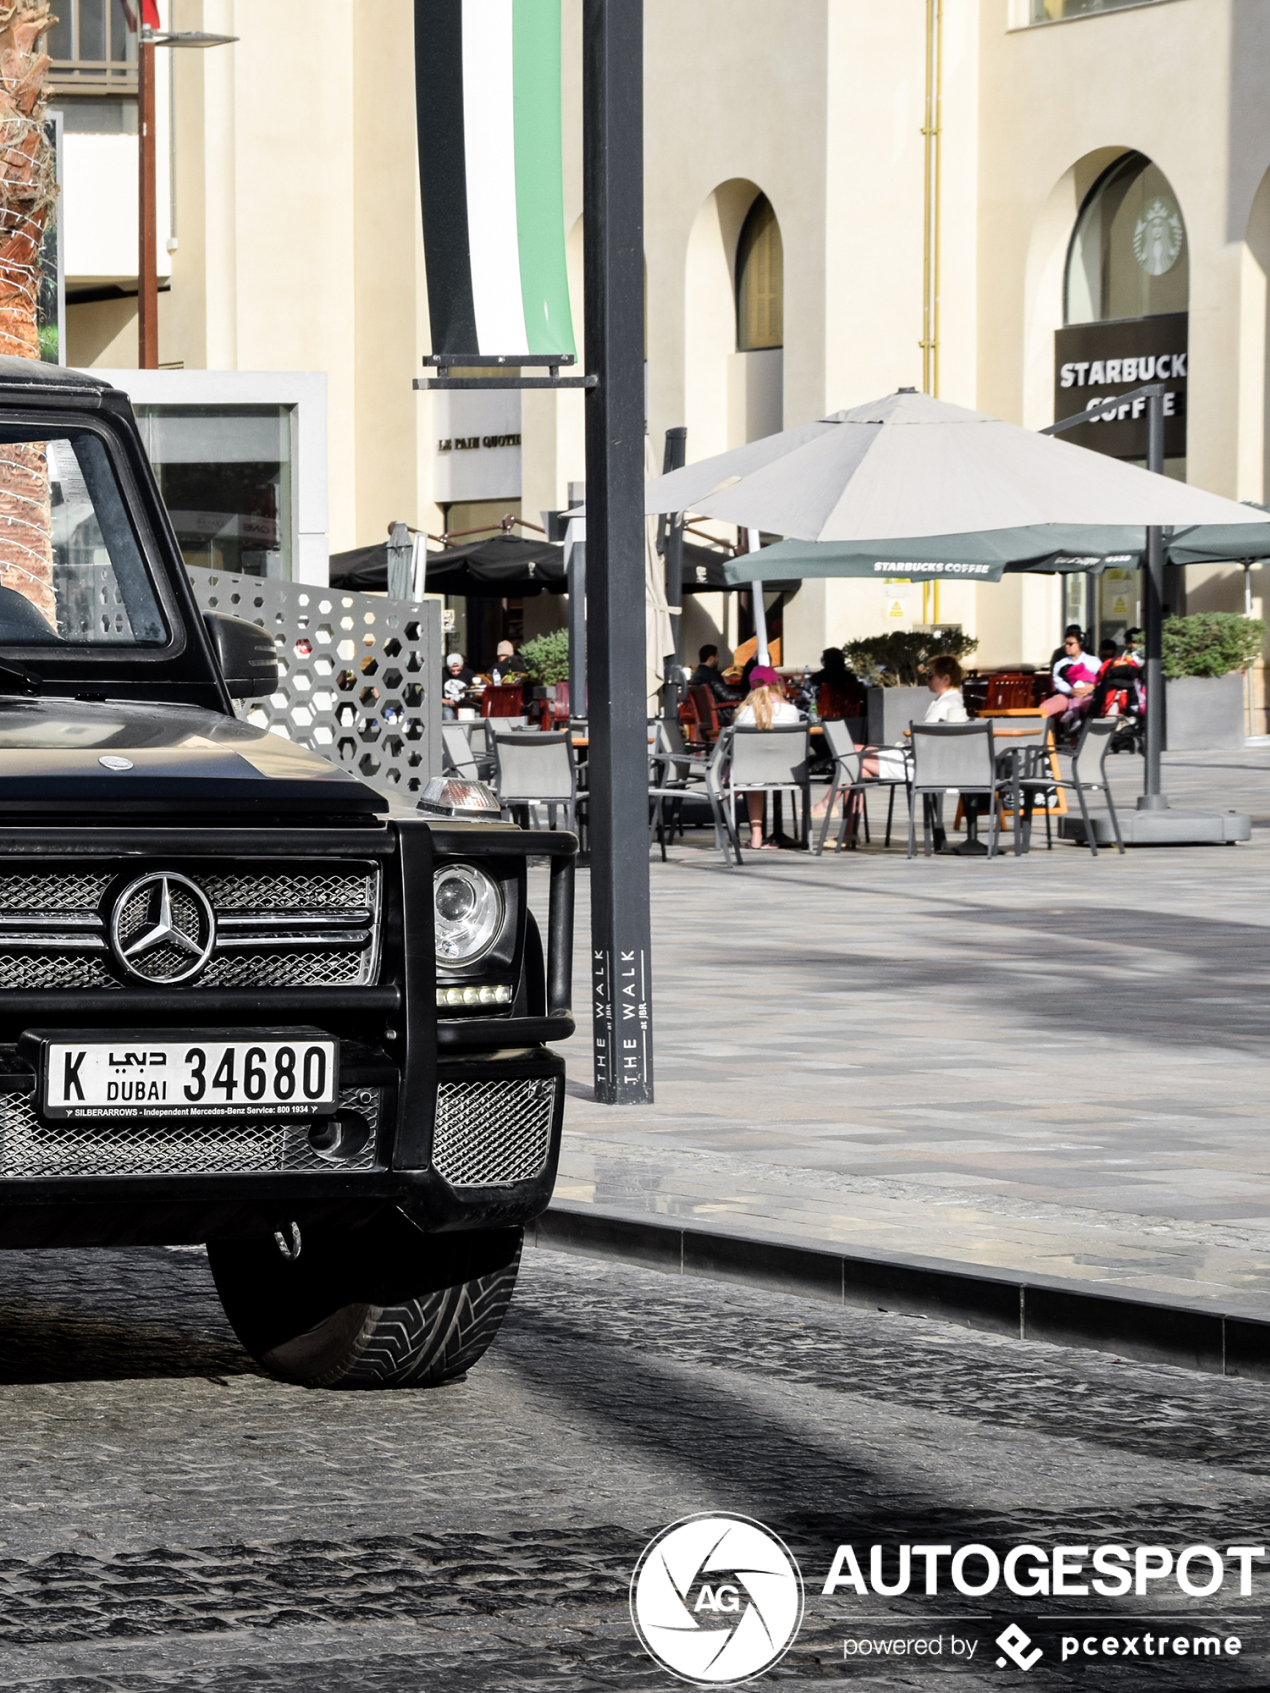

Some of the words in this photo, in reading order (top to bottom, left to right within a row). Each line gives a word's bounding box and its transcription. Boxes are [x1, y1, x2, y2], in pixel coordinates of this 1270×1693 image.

[1086, 392, 1176, 423] COFFE
[455, 437, 480, 450] PAIN
[874, 561, 944, 572] STARBUCKS
[944, 563, 990, 574] COFFEE
[594, 950, 605, 1018] WALK
[621, 950, 636, 1020] WALK
[638, 1002, 649, 1019] JBR
[640, 1020, 648, 1030] at
[108, 1052, 167, 1074] دبي
[596, 1038, 606, 1082] THE
[623, 1039, 638, 1084] THE
[63, 1051, 87, 1101] K
[183, 1046, 327, 1102] 34680
[107, 1080, 167, 1101] DUBAI
[75, 1108, 138, 1117] SILBERARROWS
[143, 1107, 189, 1117] Independent
[190, 1106, 246, 1115] Mercedes-Benz
[246, 1106, 276, 1114] Service:
[277, 1105, 290, 1114] 800
[291, 1105, 308, 1113] 1934
